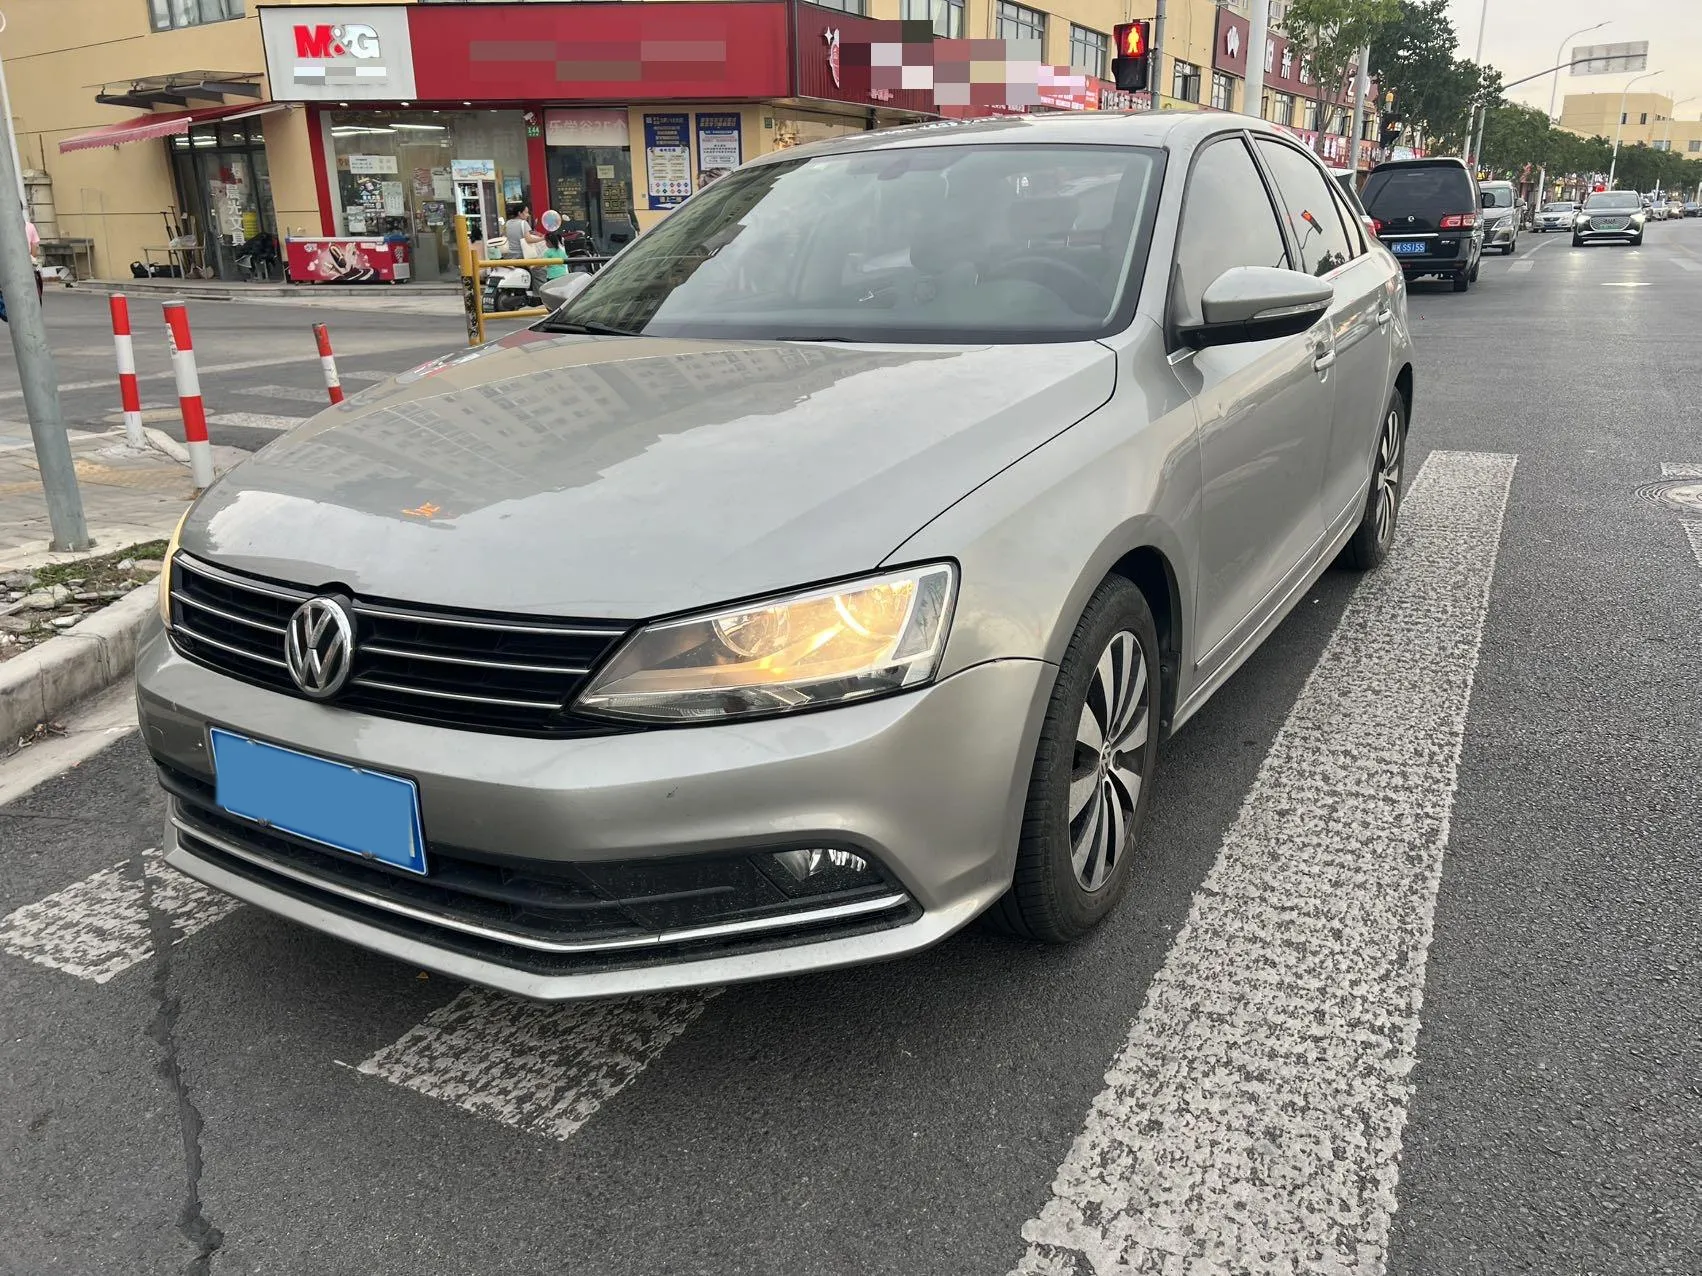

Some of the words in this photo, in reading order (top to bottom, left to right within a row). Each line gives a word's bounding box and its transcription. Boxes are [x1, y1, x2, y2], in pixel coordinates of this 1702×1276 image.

[292, 23, 382, 59] M&G
[225, 183, 247, 247] 晨光文具
